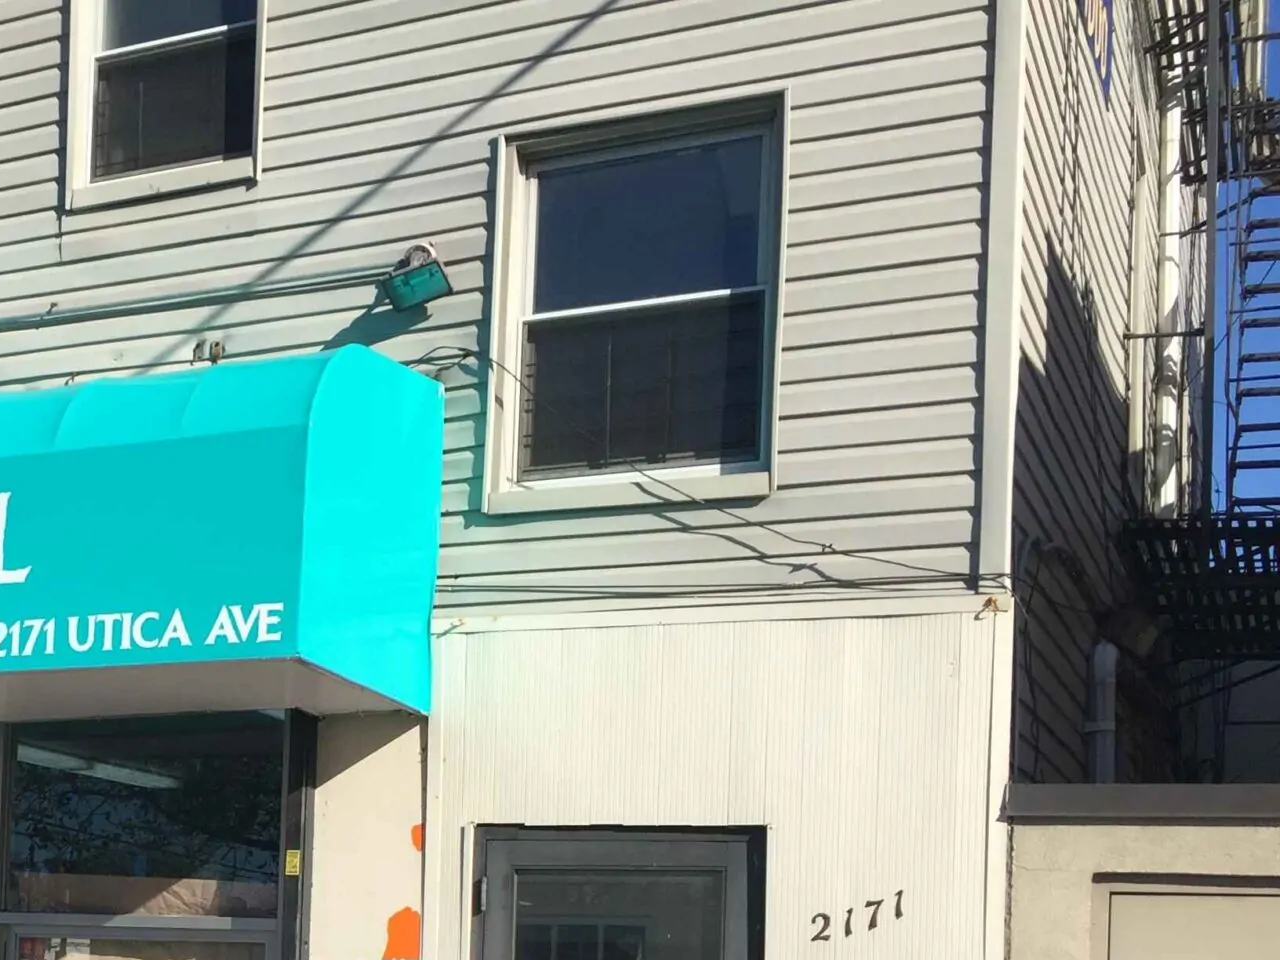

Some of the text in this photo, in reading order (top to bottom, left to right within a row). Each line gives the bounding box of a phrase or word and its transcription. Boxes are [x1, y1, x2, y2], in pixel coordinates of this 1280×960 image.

[67, 607, 192, 653] UTICA
[204, 601, 284, 646] AVE
[810, 889, 904, 942] 2171
